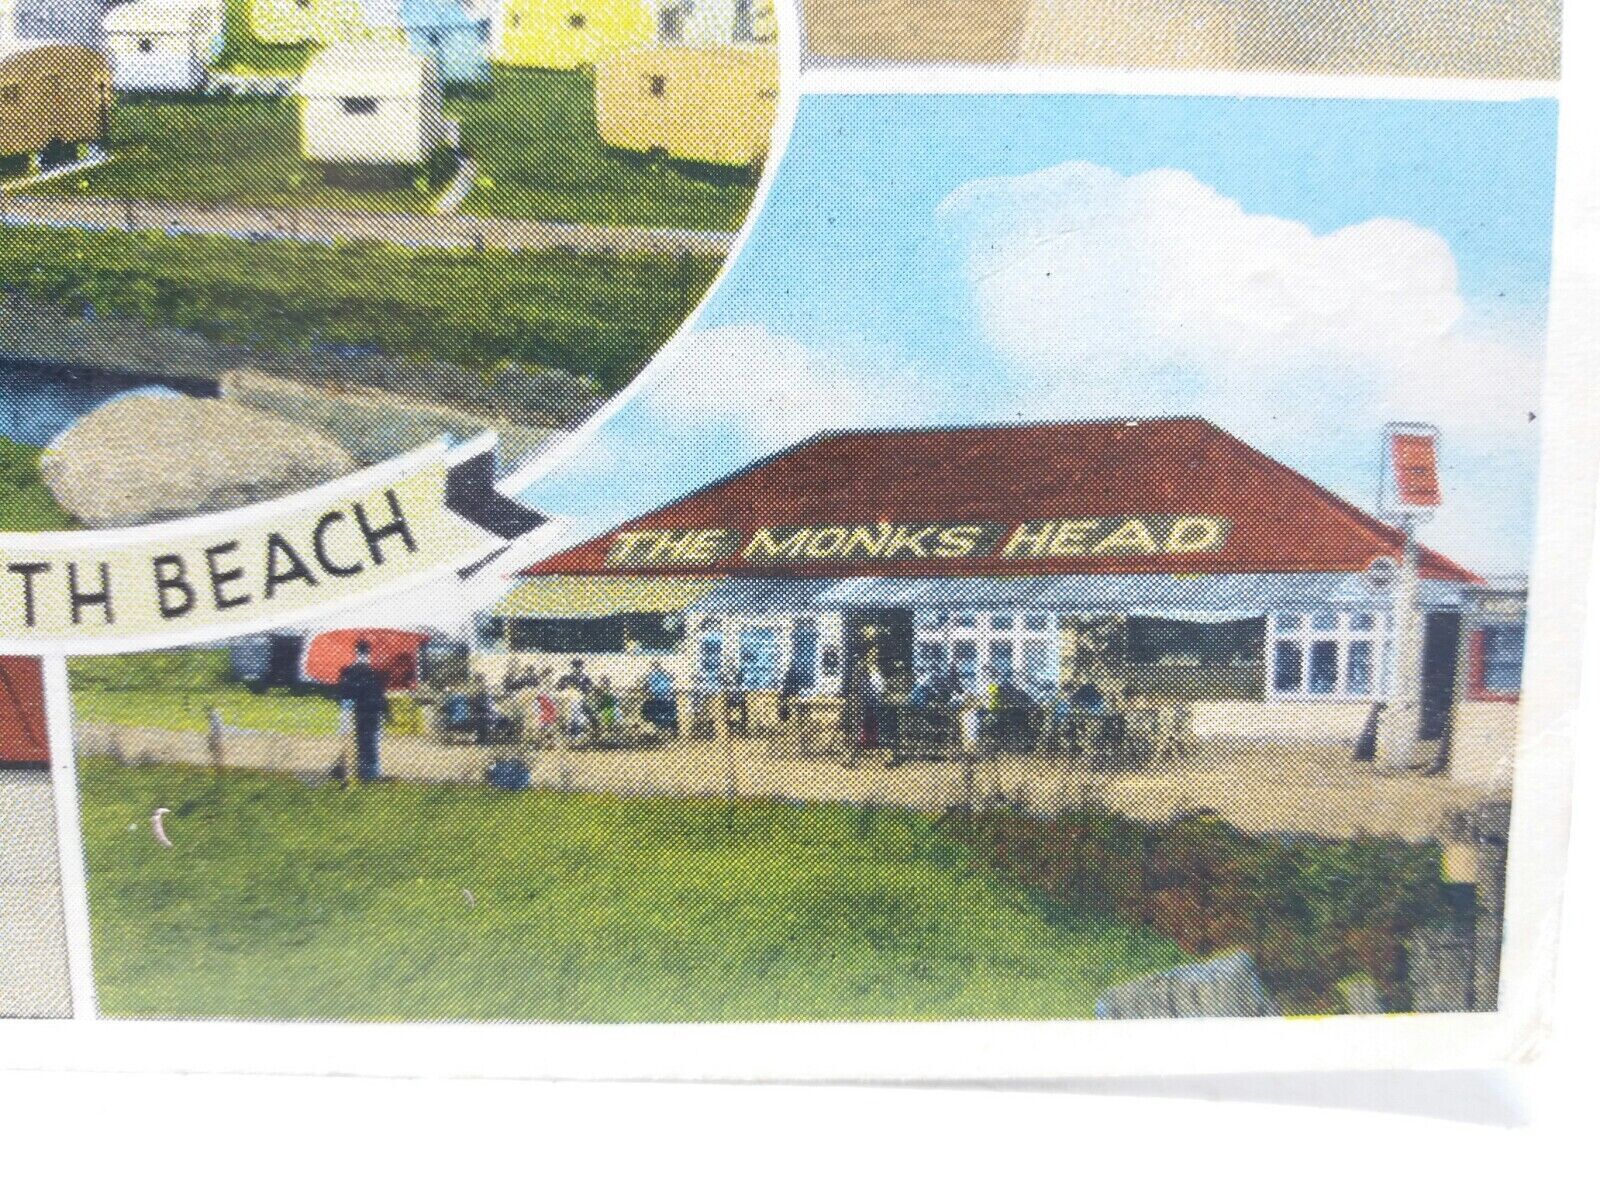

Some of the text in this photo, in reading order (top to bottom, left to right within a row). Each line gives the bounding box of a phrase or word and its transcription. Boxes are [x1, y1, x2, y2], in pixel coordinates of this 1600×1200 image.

[8, 488, 419, 627] TH BEACH
[604, 514, 1226, 567] THE MONKS HEAD
